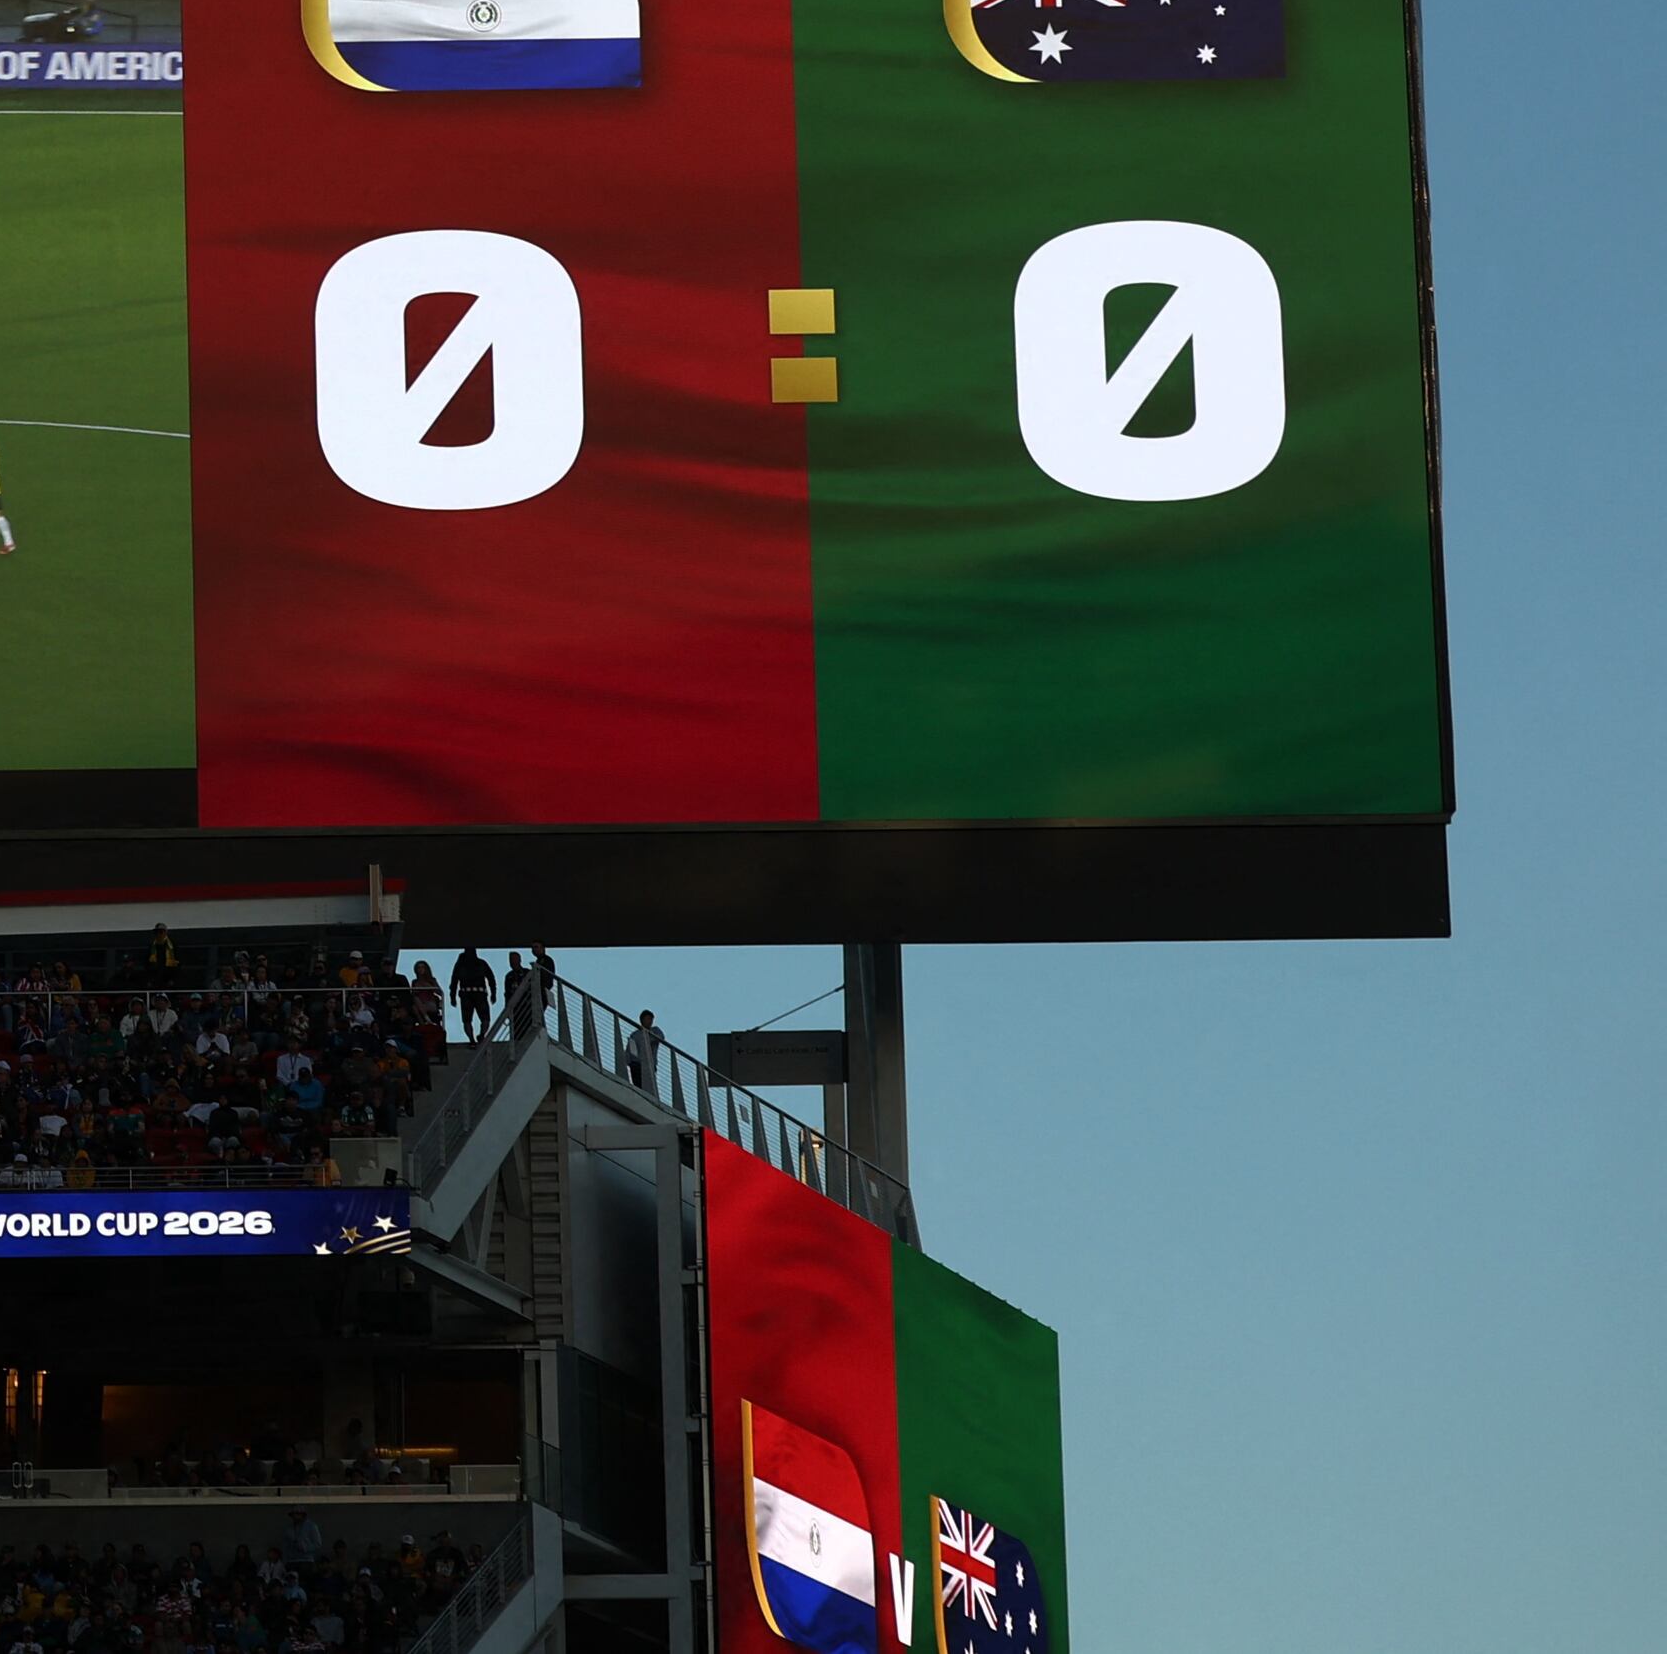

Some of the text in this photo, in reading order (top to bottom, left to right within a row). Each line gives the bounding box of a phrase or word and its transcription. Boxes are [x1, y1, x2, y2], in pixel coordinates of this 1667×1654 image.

[315, 229, 584, 511] 0
[1013, 220, 1286, 502] 0
[96, 1212, 159, 1237] CUP
[163, 1210, 273, 1236] 2026
[889, 1551, 915, 1647] V
